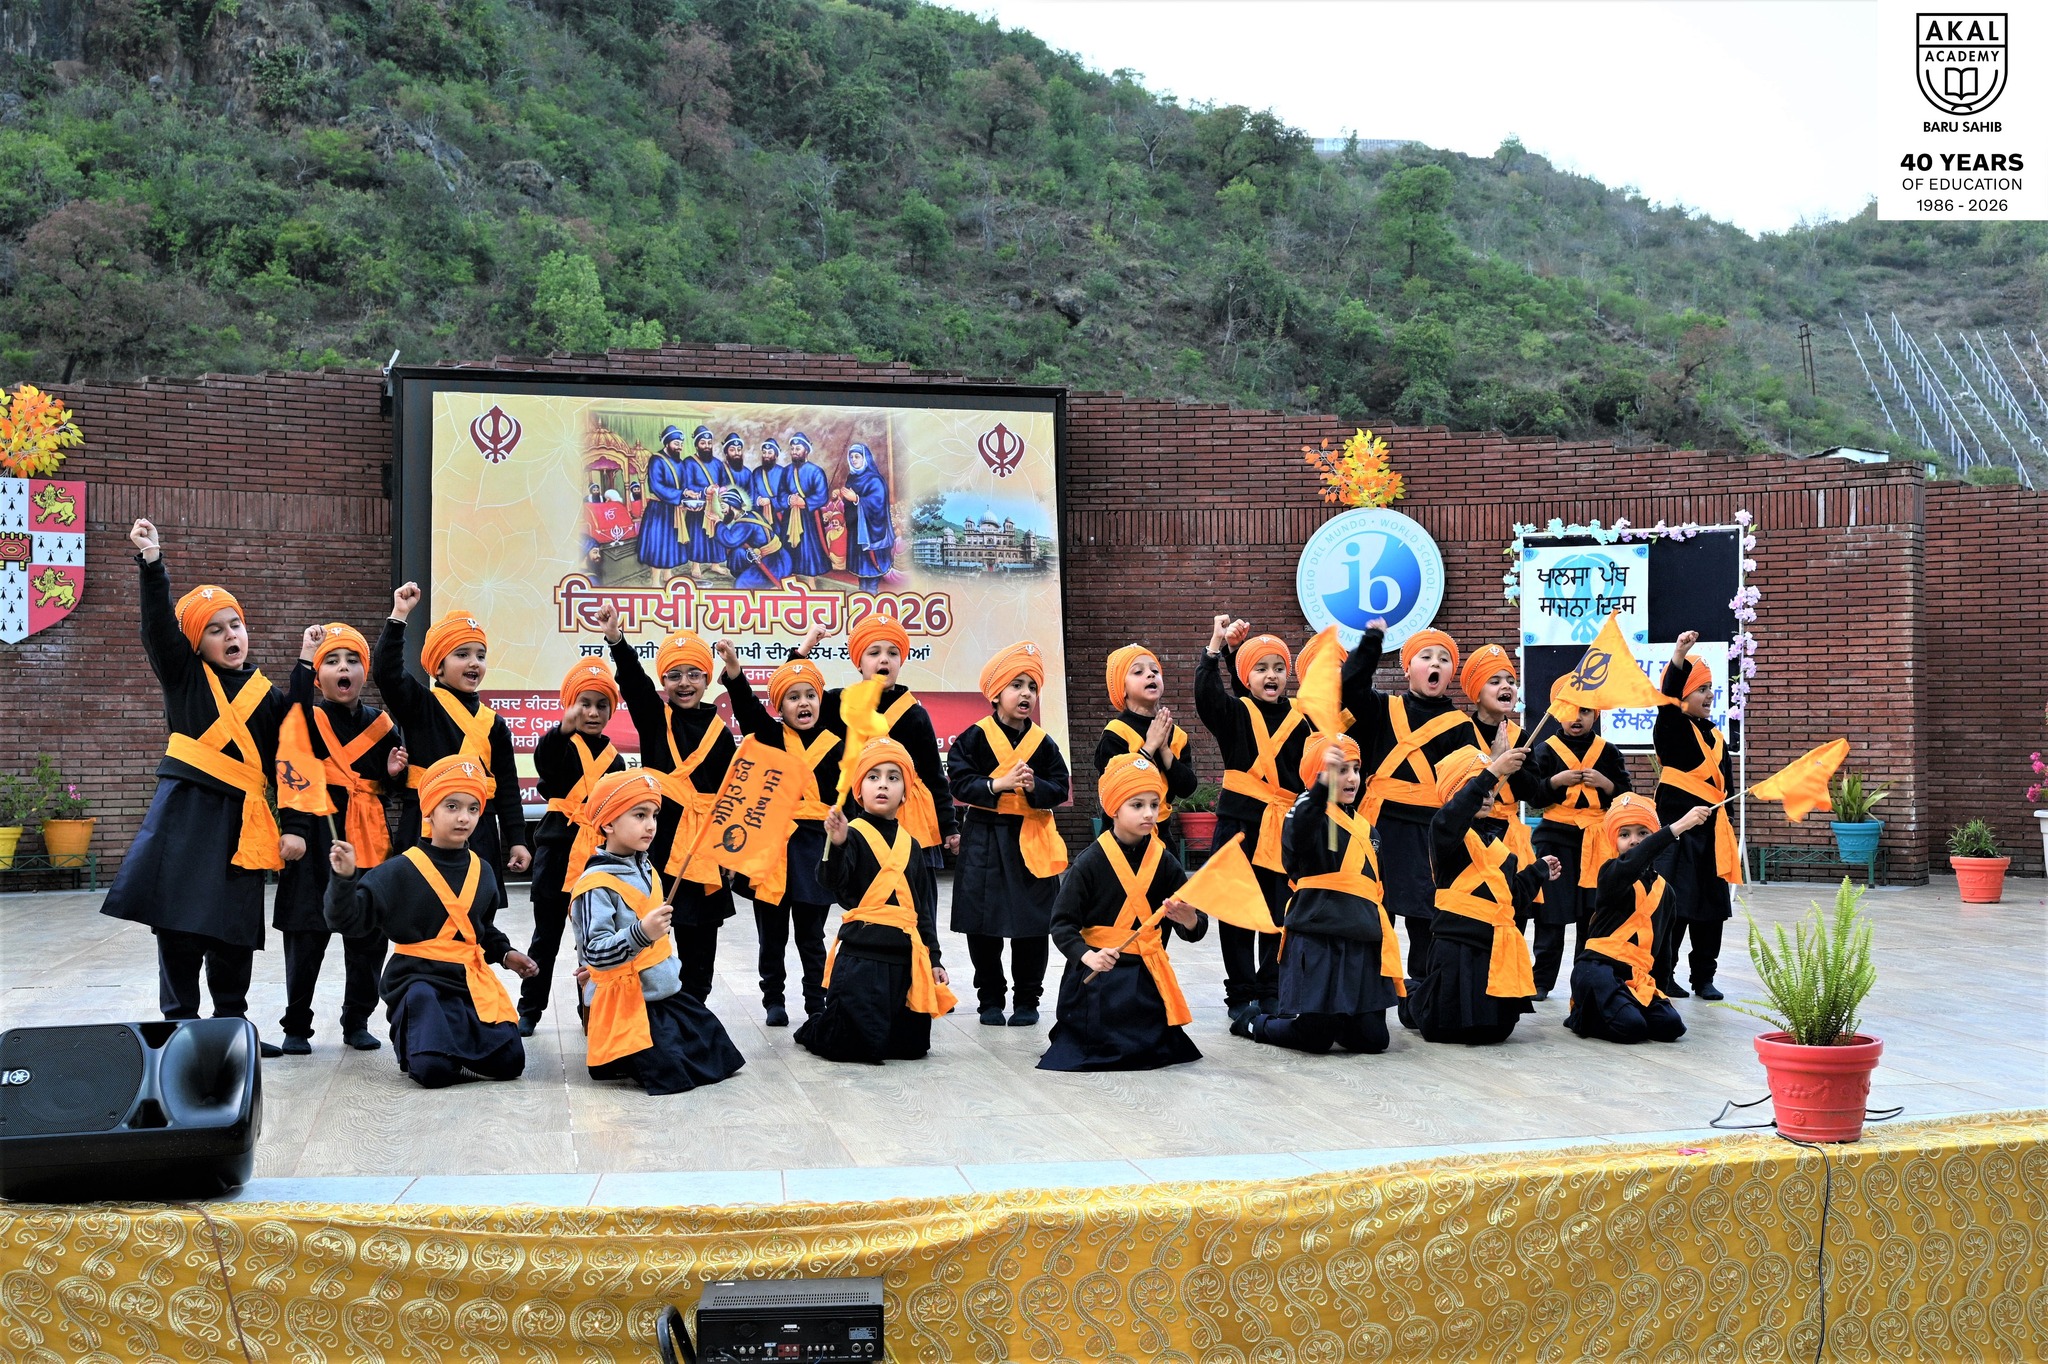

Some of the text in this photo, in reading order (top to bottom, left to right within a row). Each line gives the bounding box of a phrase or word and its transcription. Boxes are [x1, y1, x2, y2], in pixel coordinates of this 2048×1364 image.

[1306, 518, 1367, 620] COLEGIO DEL MUNDO
[1380, 518, 1436, 592] WORLD SCHOOL
[1341, 541, 1402, 615] ib
[1537, 566, 1592, 588] ਖਾਲਸਾ
[702, 579, 842, 632] ਸਮਾਰੋਹ
[850, 595, 950, 633] 2026
[1538, 597, 1592, 618] ਸਾਜਨਾ
[489, 694, 565, 711] ਸ਼ਬਦ ਕੀਰਤ
[503, 716, 560, 732] ਸ਼ਣ (Spe
